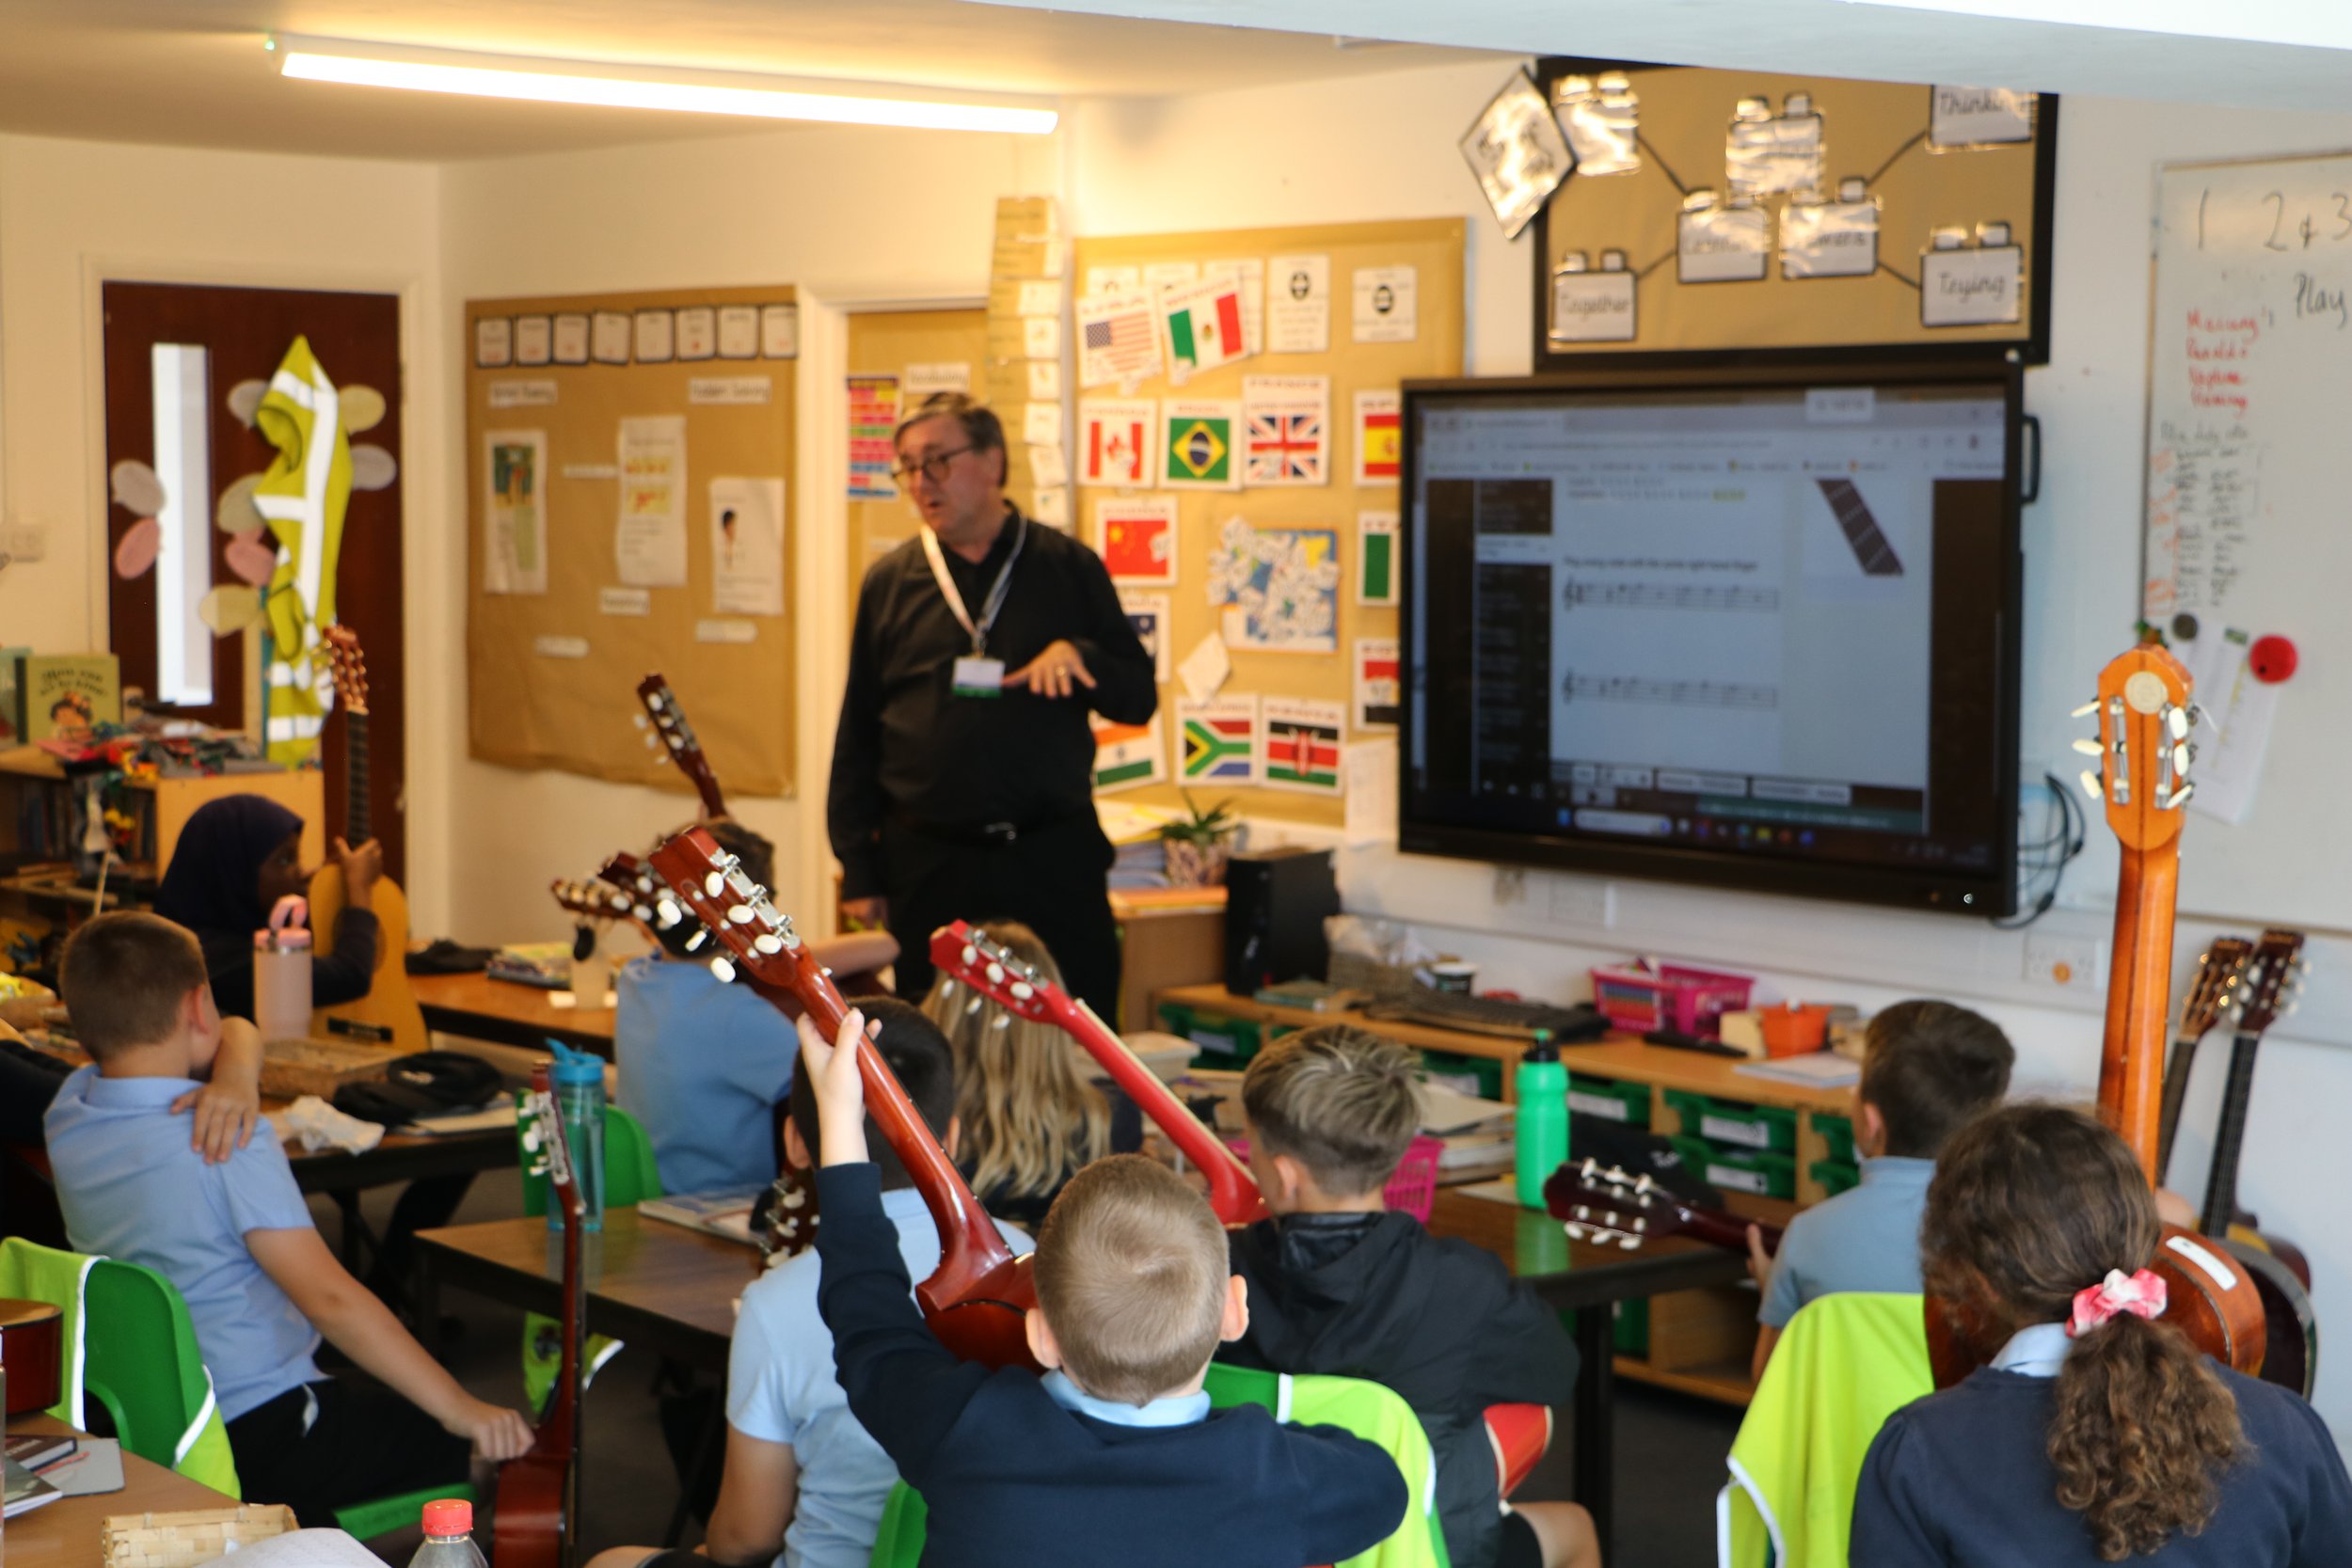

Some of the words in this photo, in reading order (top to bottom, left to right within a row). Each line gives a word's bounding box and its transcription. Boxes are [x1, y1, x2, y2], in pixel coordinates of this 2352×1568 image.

[2262, 190, 2289, 252] 2
[2330, 191, 2352, 242] 3
[1561, 291, 1629, 323] Together
[1938, 270, 2006, 304] Trying
[2294, 271, 2349, 331] Play
